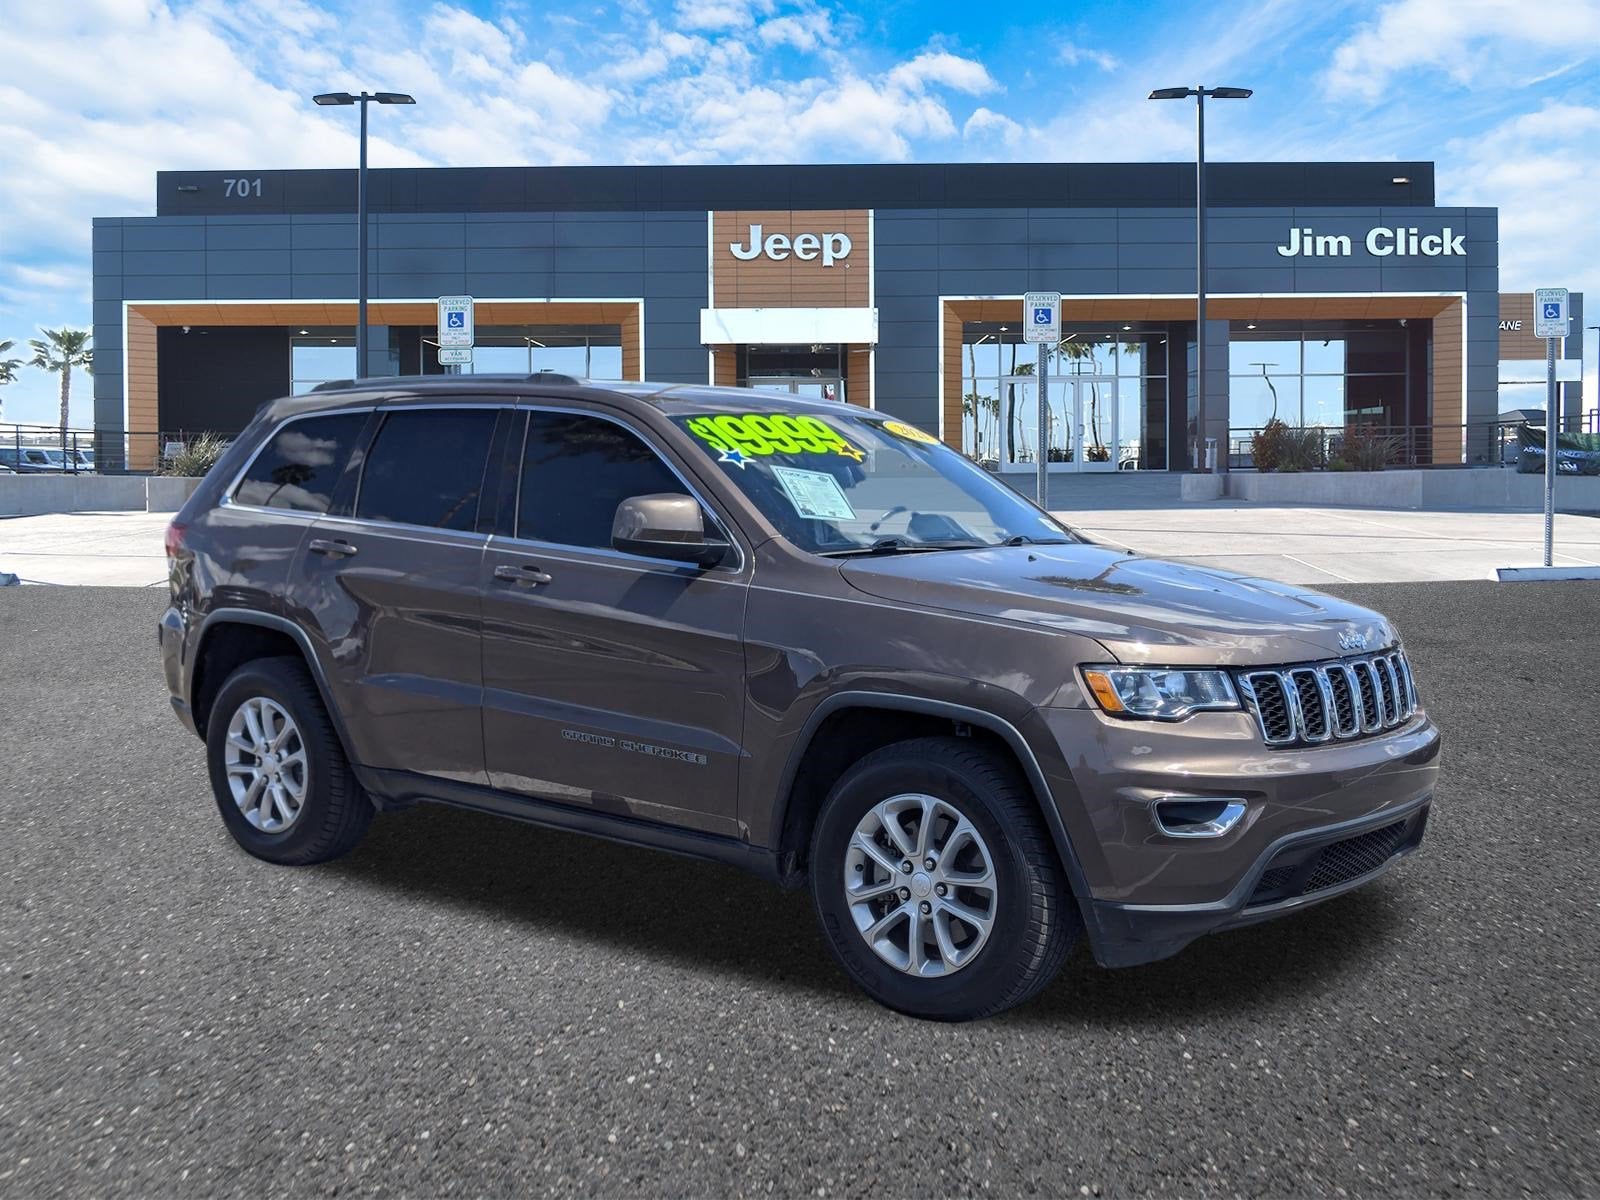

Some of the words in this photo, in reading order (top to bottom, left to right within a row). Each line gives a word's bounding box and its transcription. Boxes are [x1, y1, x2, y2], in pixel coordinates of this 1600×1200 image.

[223, 178, 262, 197] 701
[729, 223, 852, 267] Jeep
[1277, 228, 1352, 257] Jim
[1365, 227, 1467, 257] Click
[561, 729, 616, 747] GRAND
[619, 740, 708, 765] CHEROKEE
